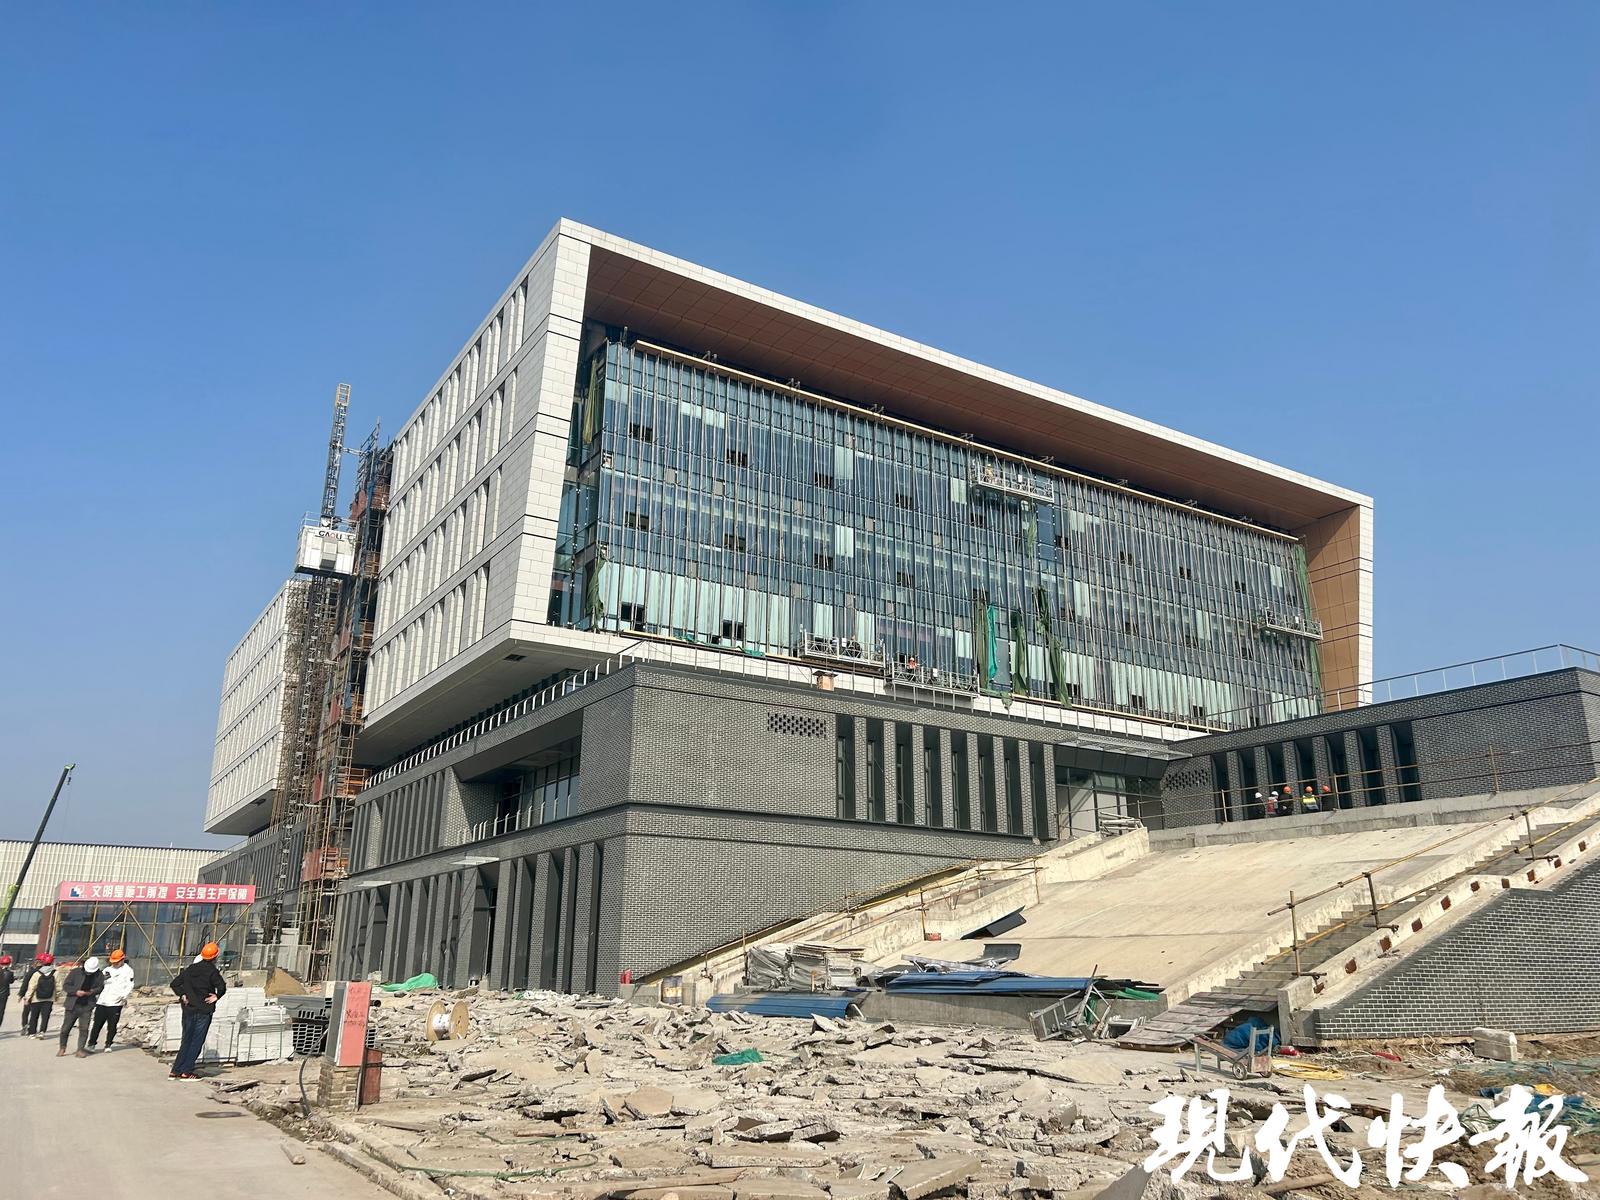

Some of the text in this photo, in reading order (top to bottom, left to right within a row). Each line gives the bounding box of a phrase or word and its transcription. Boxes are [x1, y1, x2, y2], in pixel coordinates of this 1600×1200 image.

[175, 886, 248, 900] 安全是生产保障
